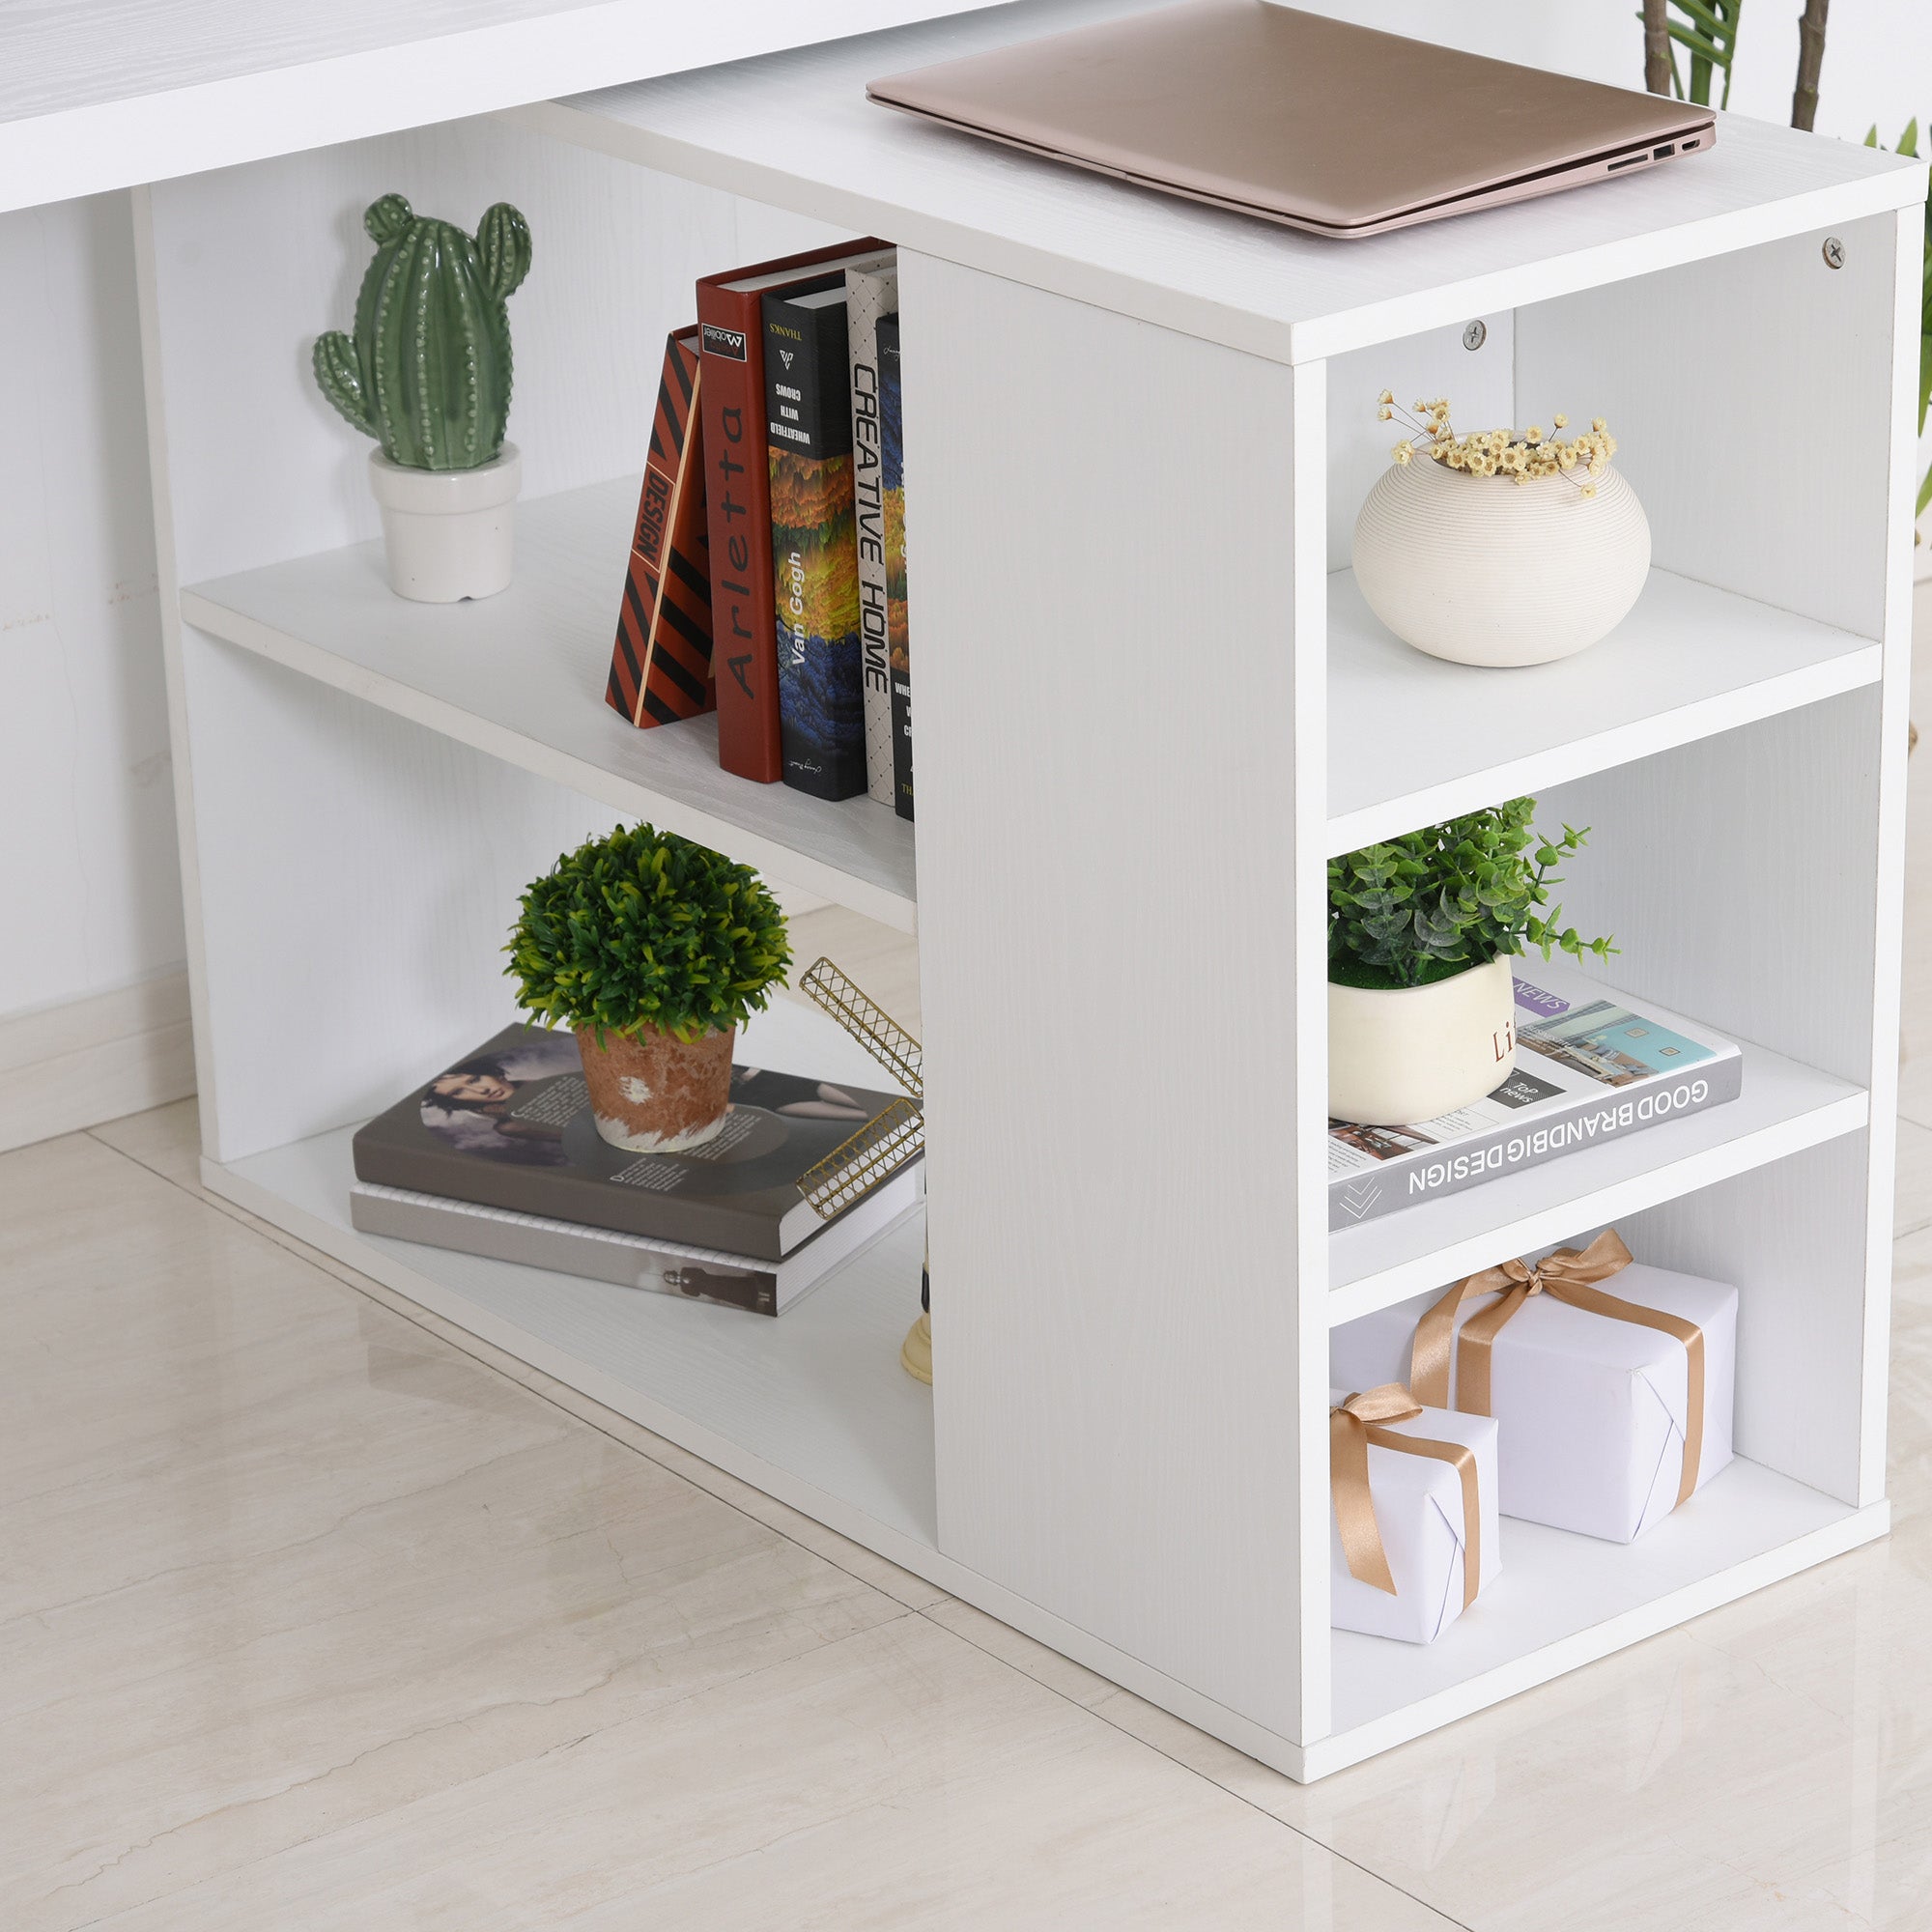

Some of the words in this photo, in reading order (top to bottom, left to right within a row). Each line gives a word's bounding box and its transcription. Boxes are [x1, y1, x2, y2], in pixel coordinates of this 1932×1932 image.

[769, 323, 803, 341] THANKS
[776, 384, 802, 402] CROWS
[780, 405, 799, 421] WITH
[770, 421, 810, 445] WHEATFIELD
[854, 362, 884, 566] CREATIVE
[637, 470, 668, 562] DESIGN
[718, 406, 754, 699] Arletta
[787, 552, 806, 615] Gogh
[791, 622, 807, 666] Van
[861, 579, 889, 694] HOME
[1514, 981, 1567, 1009] NEWS
[1499, 1088, 1534, 1103] news
[1637, 1079, 1709, 1122] GOOD
[1507, 1105, 1634, 1161] BRANDBIG
[1408, 1144, 1502, 1195] DESIGN
